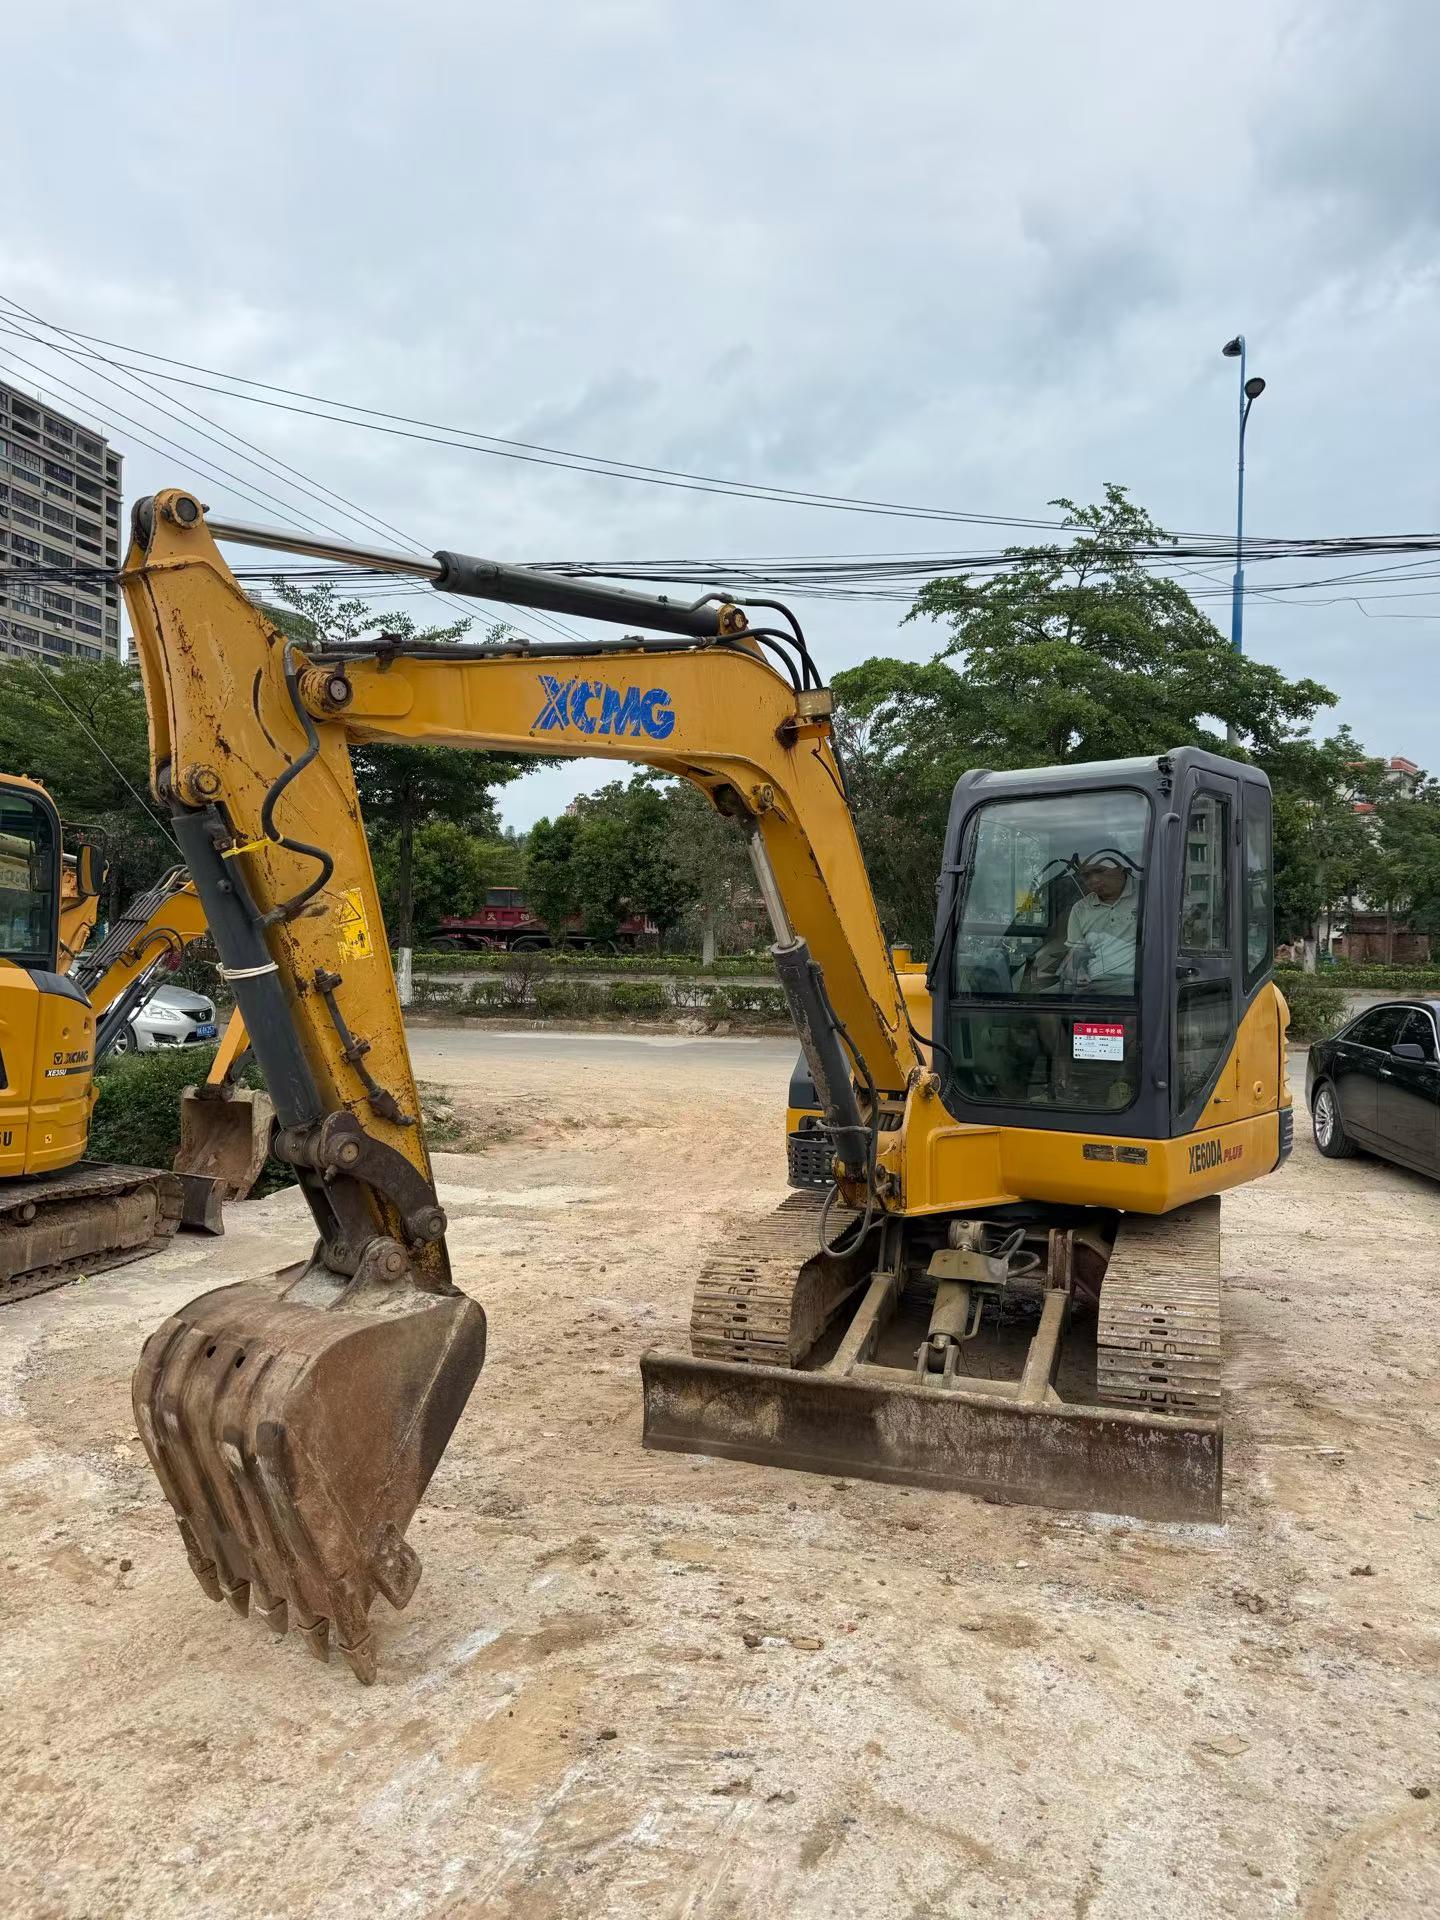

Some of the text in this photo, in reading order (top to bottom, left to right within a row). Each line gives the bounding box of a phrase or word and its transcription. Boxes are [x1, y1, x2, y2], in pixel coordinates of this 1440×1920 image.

[531, 675, 676, 740] XCMG
[0, 1131, 12, 1147] U
[1188, 1138, 1243, 1175] XE60DA PLUS
